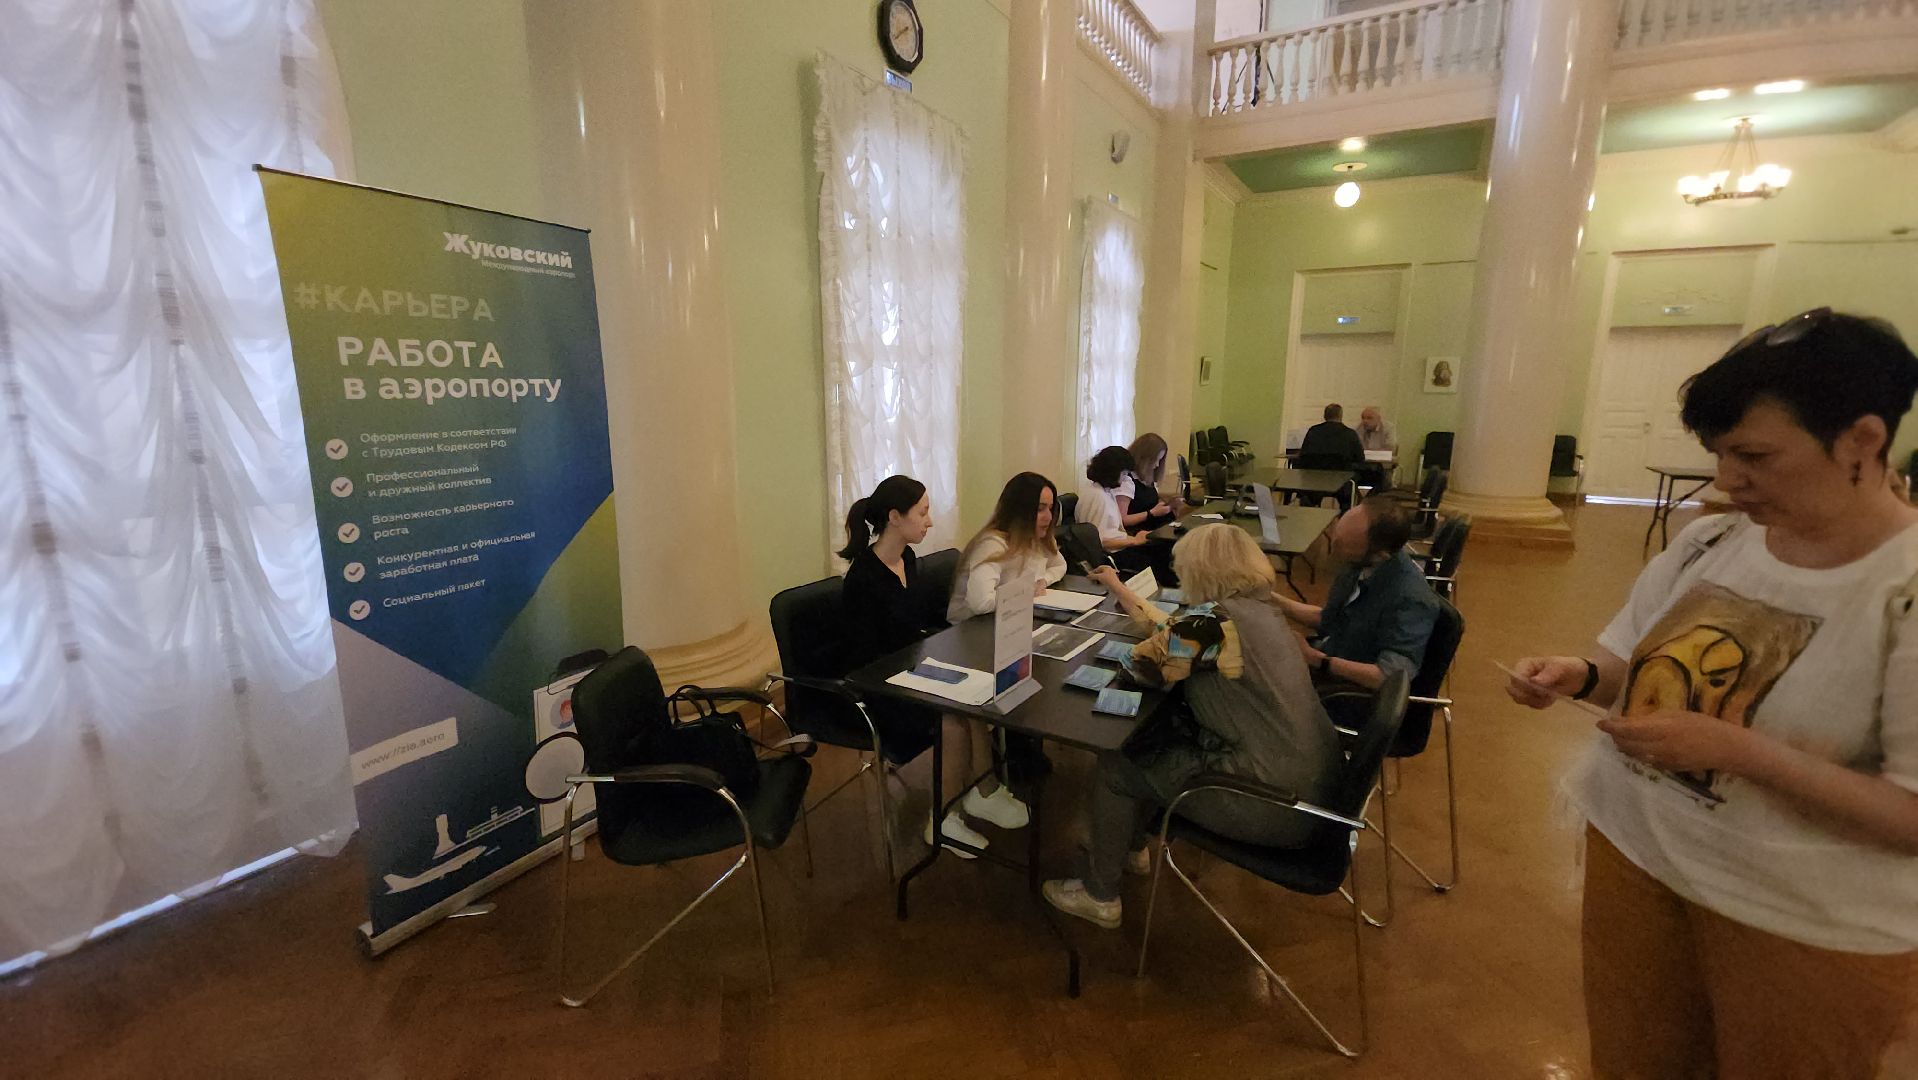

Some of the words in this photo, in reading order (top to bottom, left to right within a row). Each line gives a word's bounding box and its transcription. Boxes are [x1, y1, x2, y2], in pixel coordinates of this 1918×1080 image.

[443, 231, 573, 269] Жуковский
[294, 281, 495, 322] #КАРЬЕРА
[337, 336, 504, 368] РАБОТА
[343, 377, 367, 400] в
[378, 377, 562, 405] аэропорту
[360, 431, 439, 443] Оформление
[450, 427, 517, 438] соответствии
[362, 450, 369, 458] с
[372, 444, 435, 459] Трудовым
[436, 442, 488, 453] Кодексом
[490, 439, 507, 449] РФ
[366, 464, 480, 484] Профессиональный
[379, 482, 436, 498] дружный
[438, 477, 492, 491] коллектив
[372, 507, 452, 525] Возможность
[453, 499, 514, 513] карьерного
[373, 526, 410, 541] роста
[377, 545, 459, 566] Конкурентная
[461, 543, 468, 551] и
[470, 531, 536, 549] официальная
[379, 559, 448, 580] заработная
[449, 553, 480, 567] плата
[382, 585, 456, 608] Социальный
[457, 579, 485, 592] пакет
